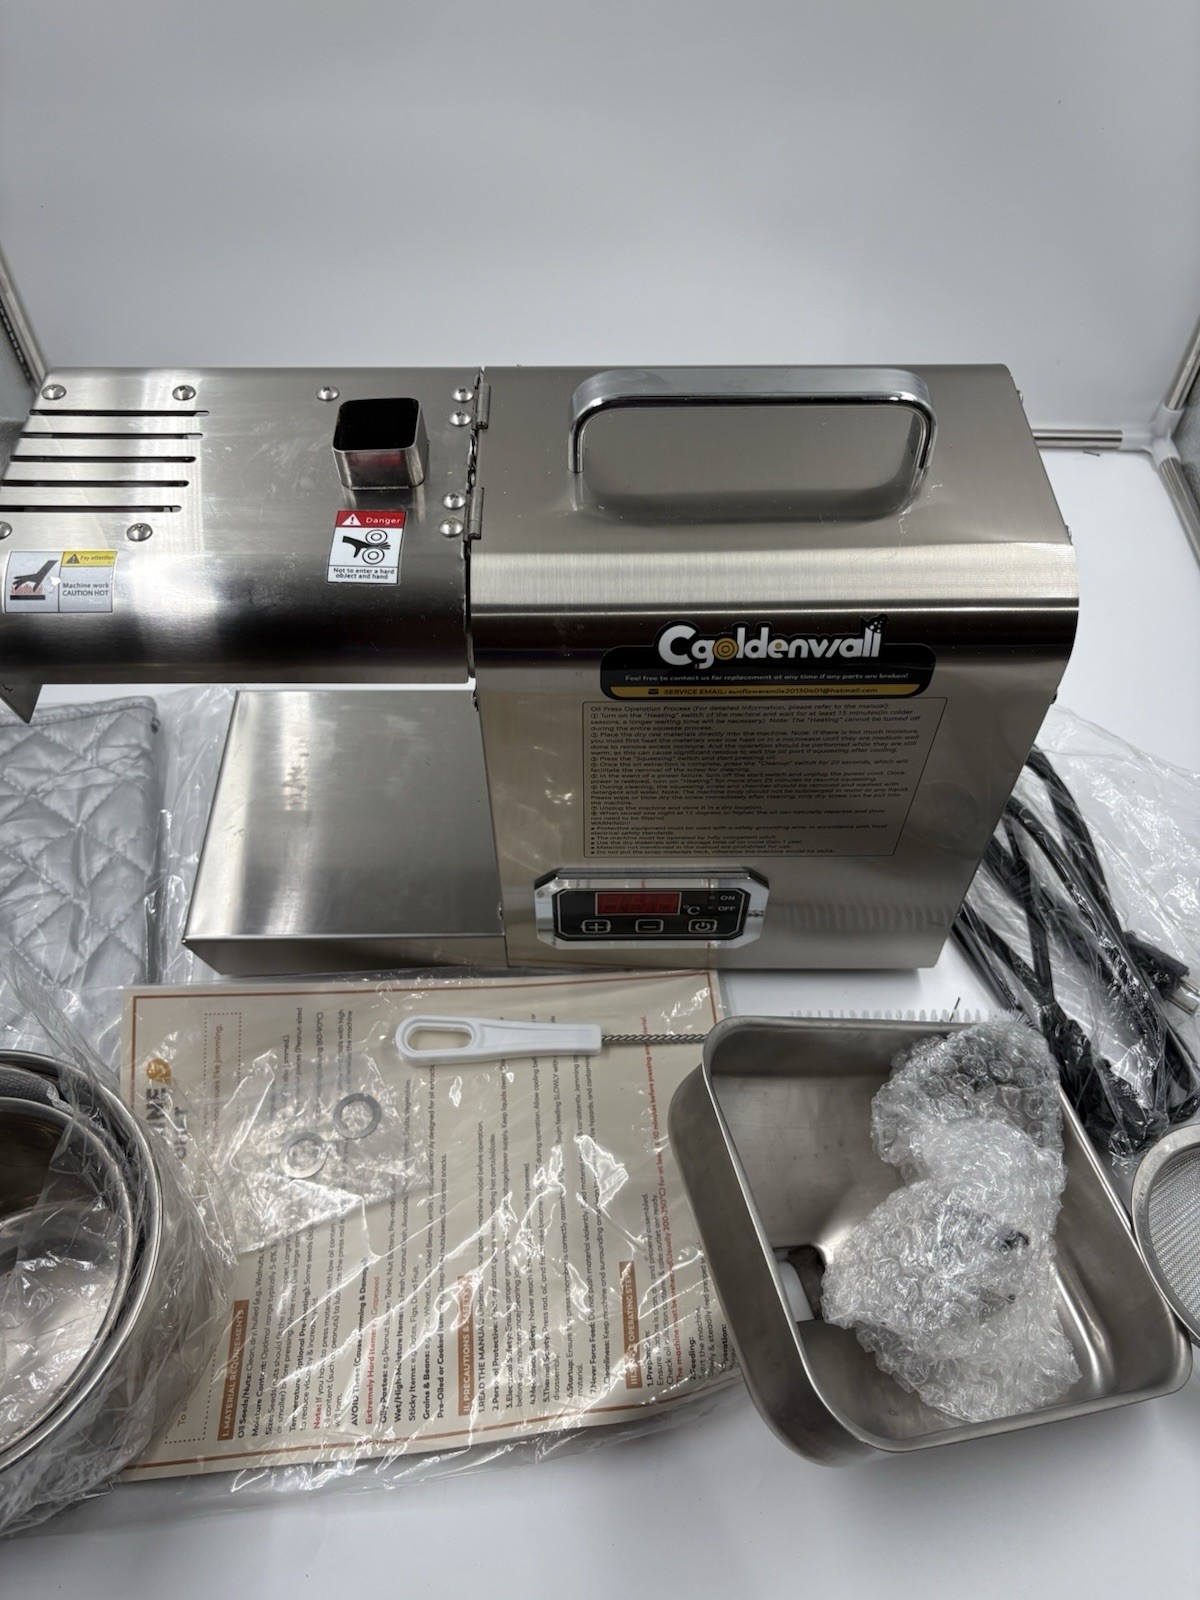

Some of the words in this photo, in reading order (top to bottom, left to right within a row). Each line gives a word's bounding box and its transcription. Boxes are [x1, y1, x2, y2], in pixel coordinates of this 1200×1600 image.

[365, 517, 400, 525] Danger
[658, 624, 882, 669] Cgoldenwall
[624, 705, 661, 713] Operation
[742, 704, 785, 712] information,
[788, 704, 812, 712] please
[214, 1024, 223, 1063] jamming.
[532, 1070, 540, 1091] cooling
[645, 1057, 654, 1082] pressing
[532, 1092, 540, 1109] Allow
[552, 1075, 560, 1101] SLOWLY
[648, 1083, 656, 1103] before
[651, 1105, 659, 1129] minutes
[423, 1381, 430, 1389] &
[428, 1111, 436, 1140] designed
[584, 1242, 592, 1274] material
[596, 1227, 606, 1271] surrounding
[266, 1271, 276, 1303] typically
[586, 1276, 594, 1293] push
[599, 1273, 607, 1286] and
[600, 1288, 609, 1319] machine
[250, 1307, 259, 1330] hulled
[602, 1321, 610, 1339] Keep
[626, 1295, 635, 1341] OPERATING
[261, 1327, 272, 1359] Optimal
[321, 1327, 329, 1346] press
[368, 1330, 376, 1355] Items:
[528, 1322, 537, 1351] Safety:
[246, 1347, 255, 1371] Clean,
[320, 1348, 327, 1358] to
[325, 1384, 334, 1412] content
[331, 1315, 340, 1349] peanuts)
[224, 1382, 237, 1429] MATERIAL
[231, 1310, 244, 1380] REQUIREMENTS
[367, 1357, 375, 1377] Hard
[409, 1365, 417, 1392] Items:
[438, 1366, 444, 1375] or
[463, 1334, 471, 1400] PRECAUTIONS
[589, 1366, 598, 1394] 7.Never
[655, 1357, 664, 1385] Ensure
[239, 1373, 252, 1424] Seeds/Nuts:
[317, 1380, 325, 1395] you
[380, 1371, 389, 1403] Pastes:
[366, 1379, 375, 1424] Extremely
[408, 1394, 418, 1421] Sticky
[251, 1400, 263, 1436] Moisture
[313, 1404, 322, 1429] Note:
